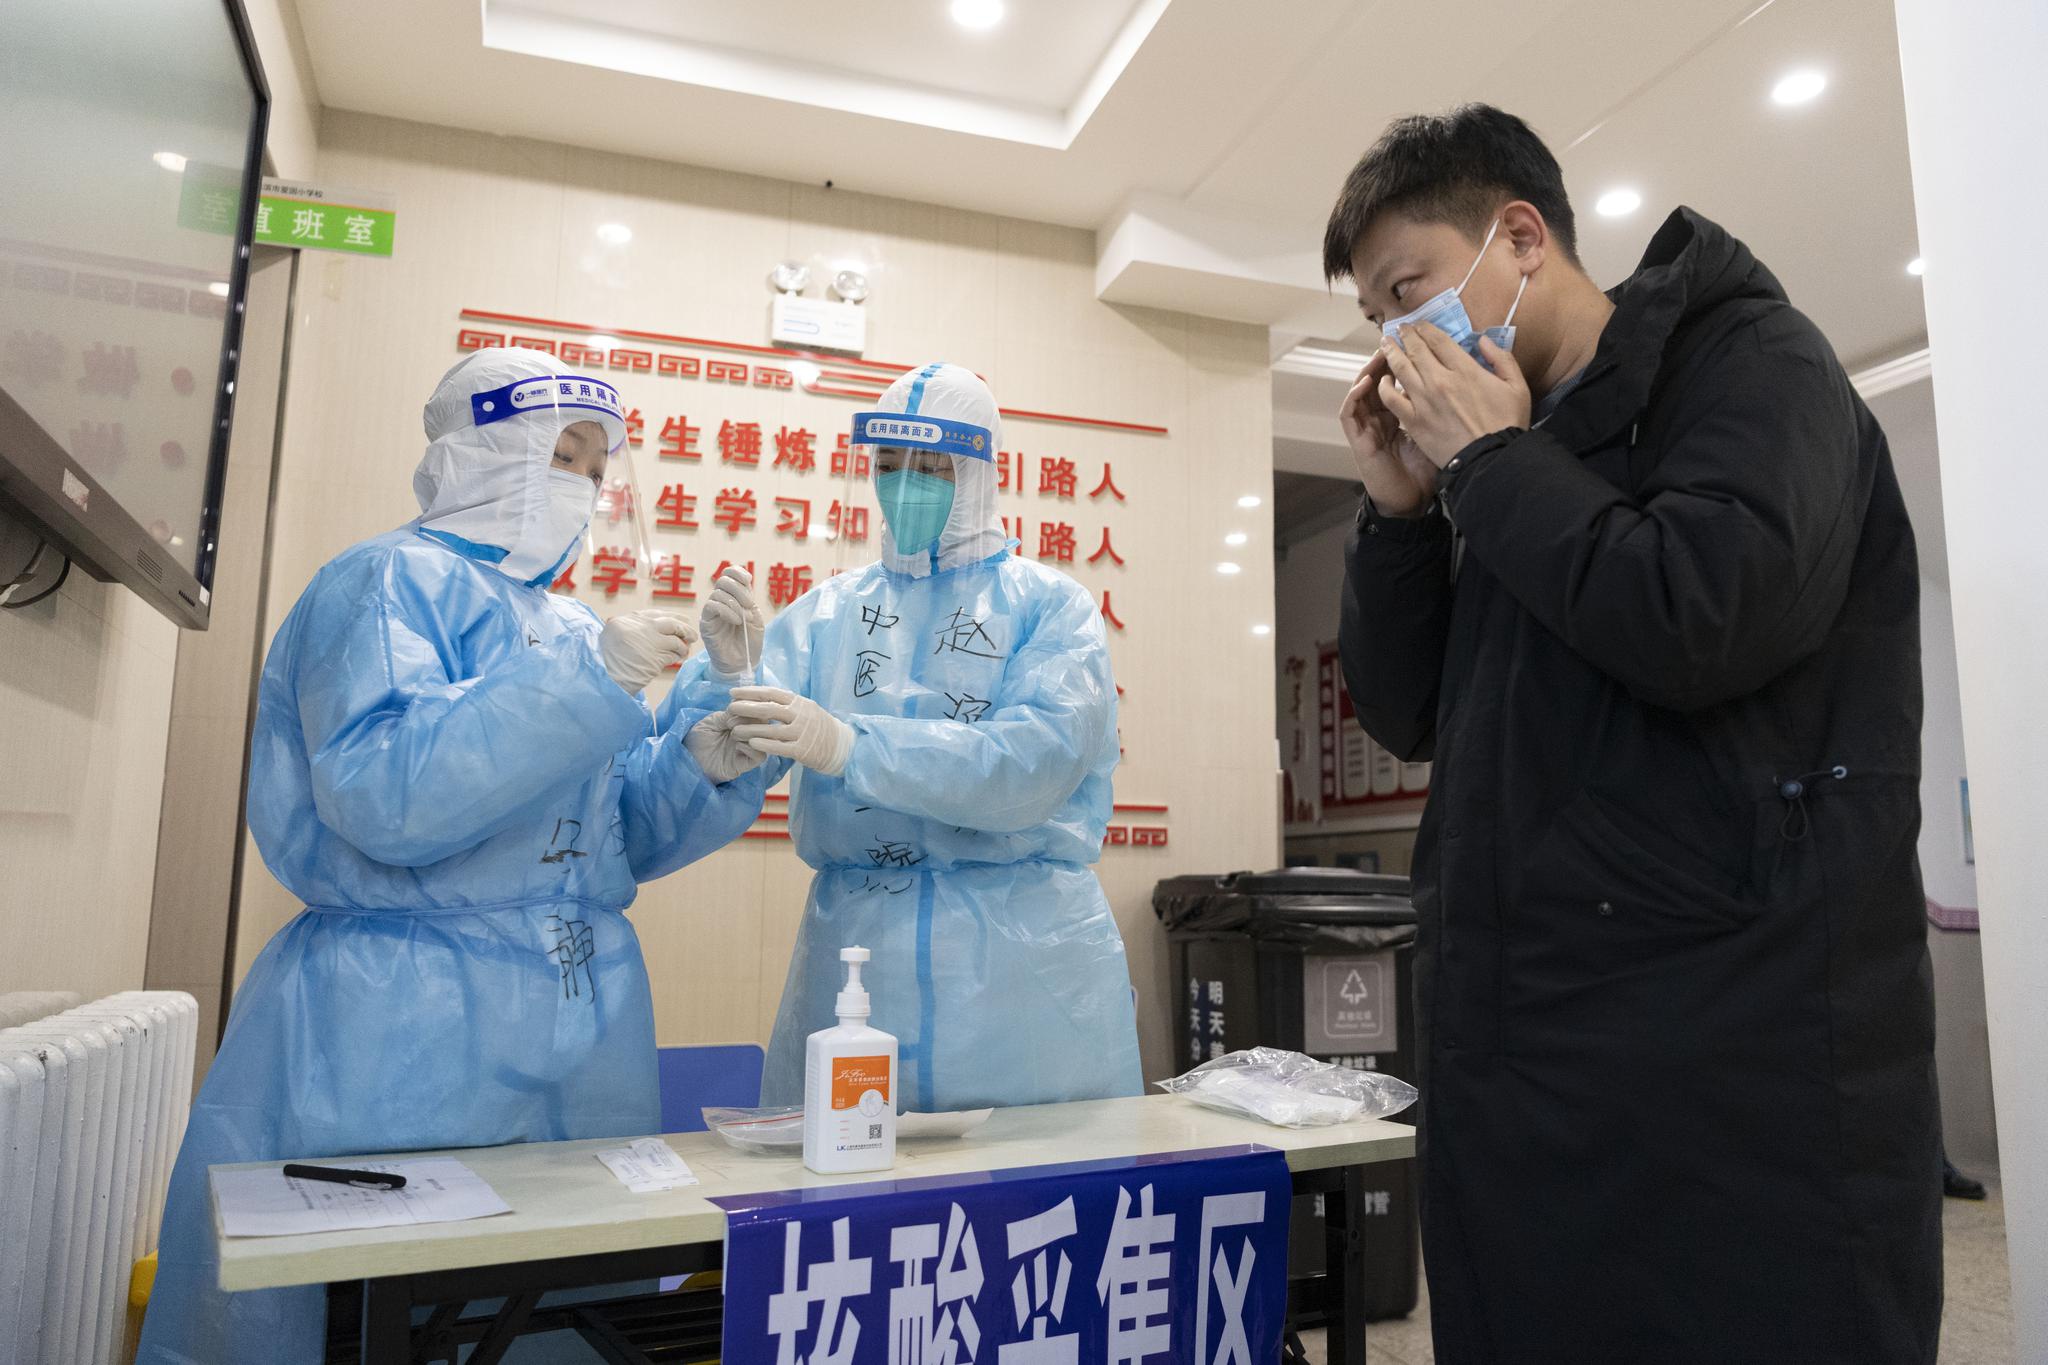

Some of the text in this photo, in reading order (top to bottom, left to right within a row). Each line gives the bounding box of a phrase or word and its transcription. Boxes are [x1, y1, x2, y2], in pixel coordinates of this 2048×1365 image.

[870, 422, 935, 439] 医用隔离面罩
